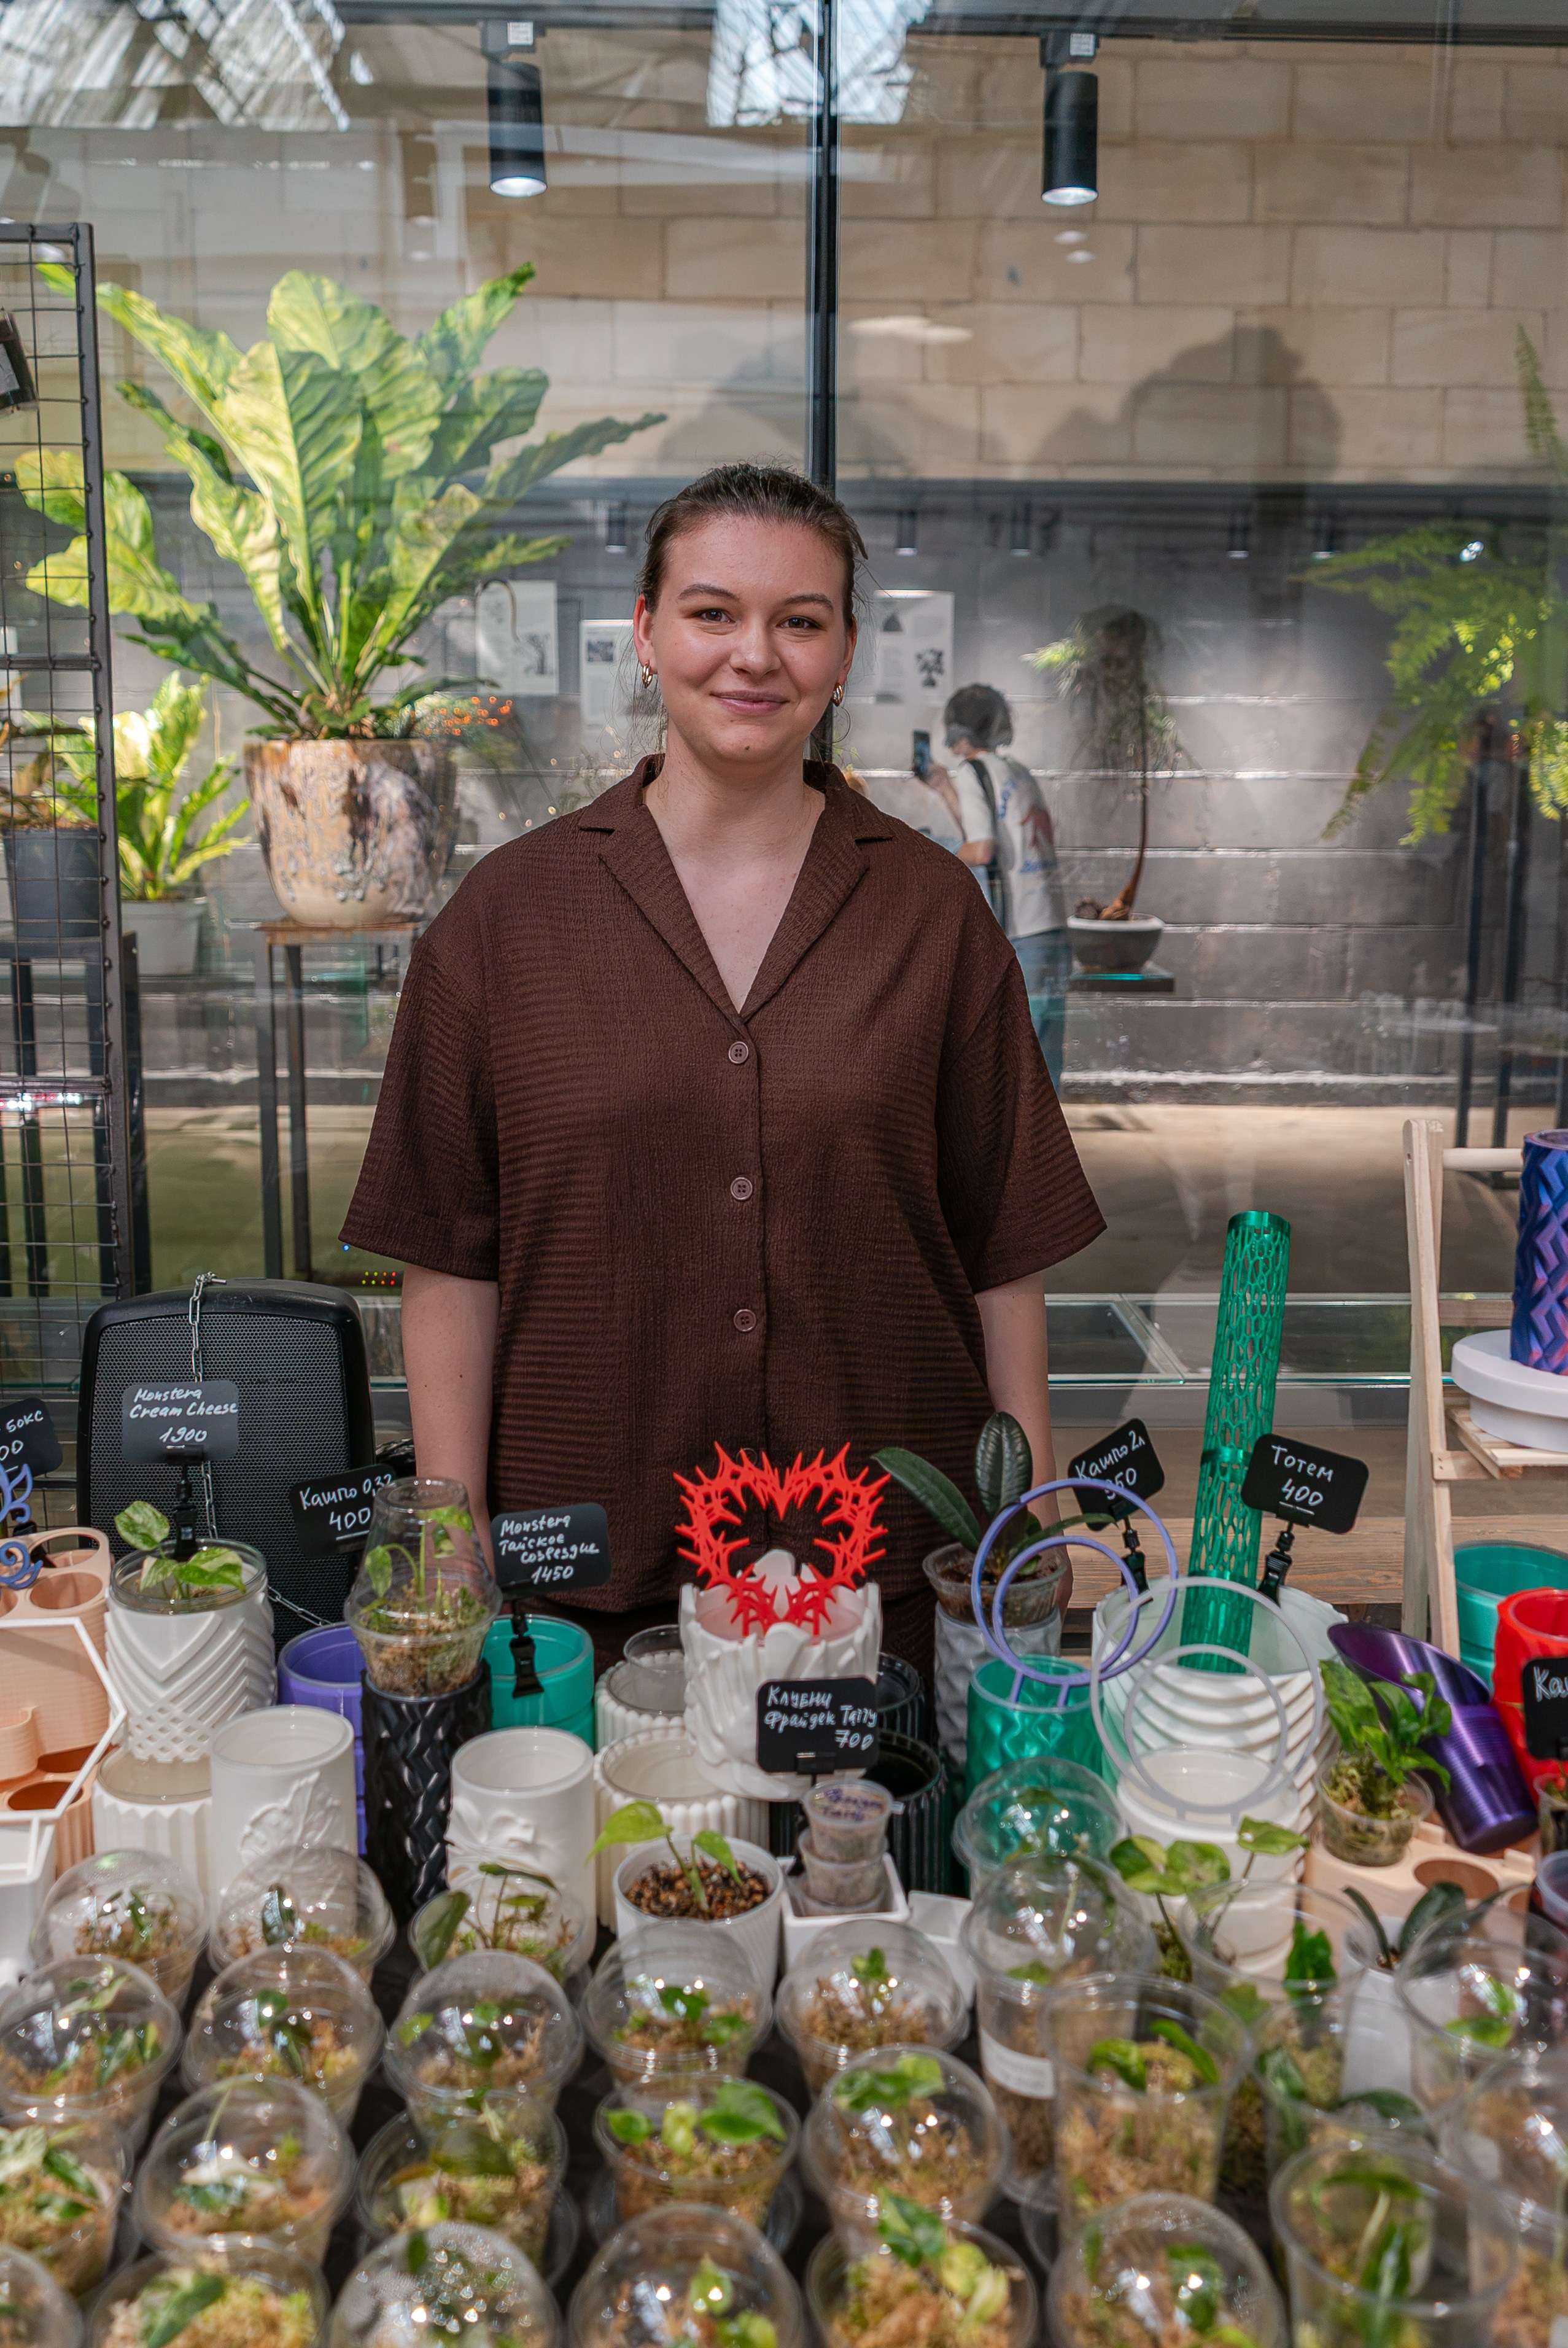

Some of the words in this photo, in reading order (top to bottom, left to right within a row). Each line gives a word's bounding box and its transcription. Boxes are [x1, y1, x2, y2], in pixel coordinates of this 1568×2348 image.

[133, 1388, 203, 1403] Monstera
[129, 1404, 183, 1419] Cream
[186, 1401, 239, 1416] Cheese
[159, 1426, 208, 1443] 1900
[1075, 1445, 1128, 1481] Кашпо
[1271, 1445, 1334, 1483] Тотем
[300, 1487, 357, 1510] Кашпо
[1281, 1478, 1324, 1507] 400
[329, 1507, 371, 1531] 400
[500, 1514, 571, 1537] Monstera
[499, 1533, 565, 1556] Тайское
[531, 1565, 574, 1585] 1450
[1534, 1666, 1568, 1702] Ка
[834, 1729, 874, 1751] 700
